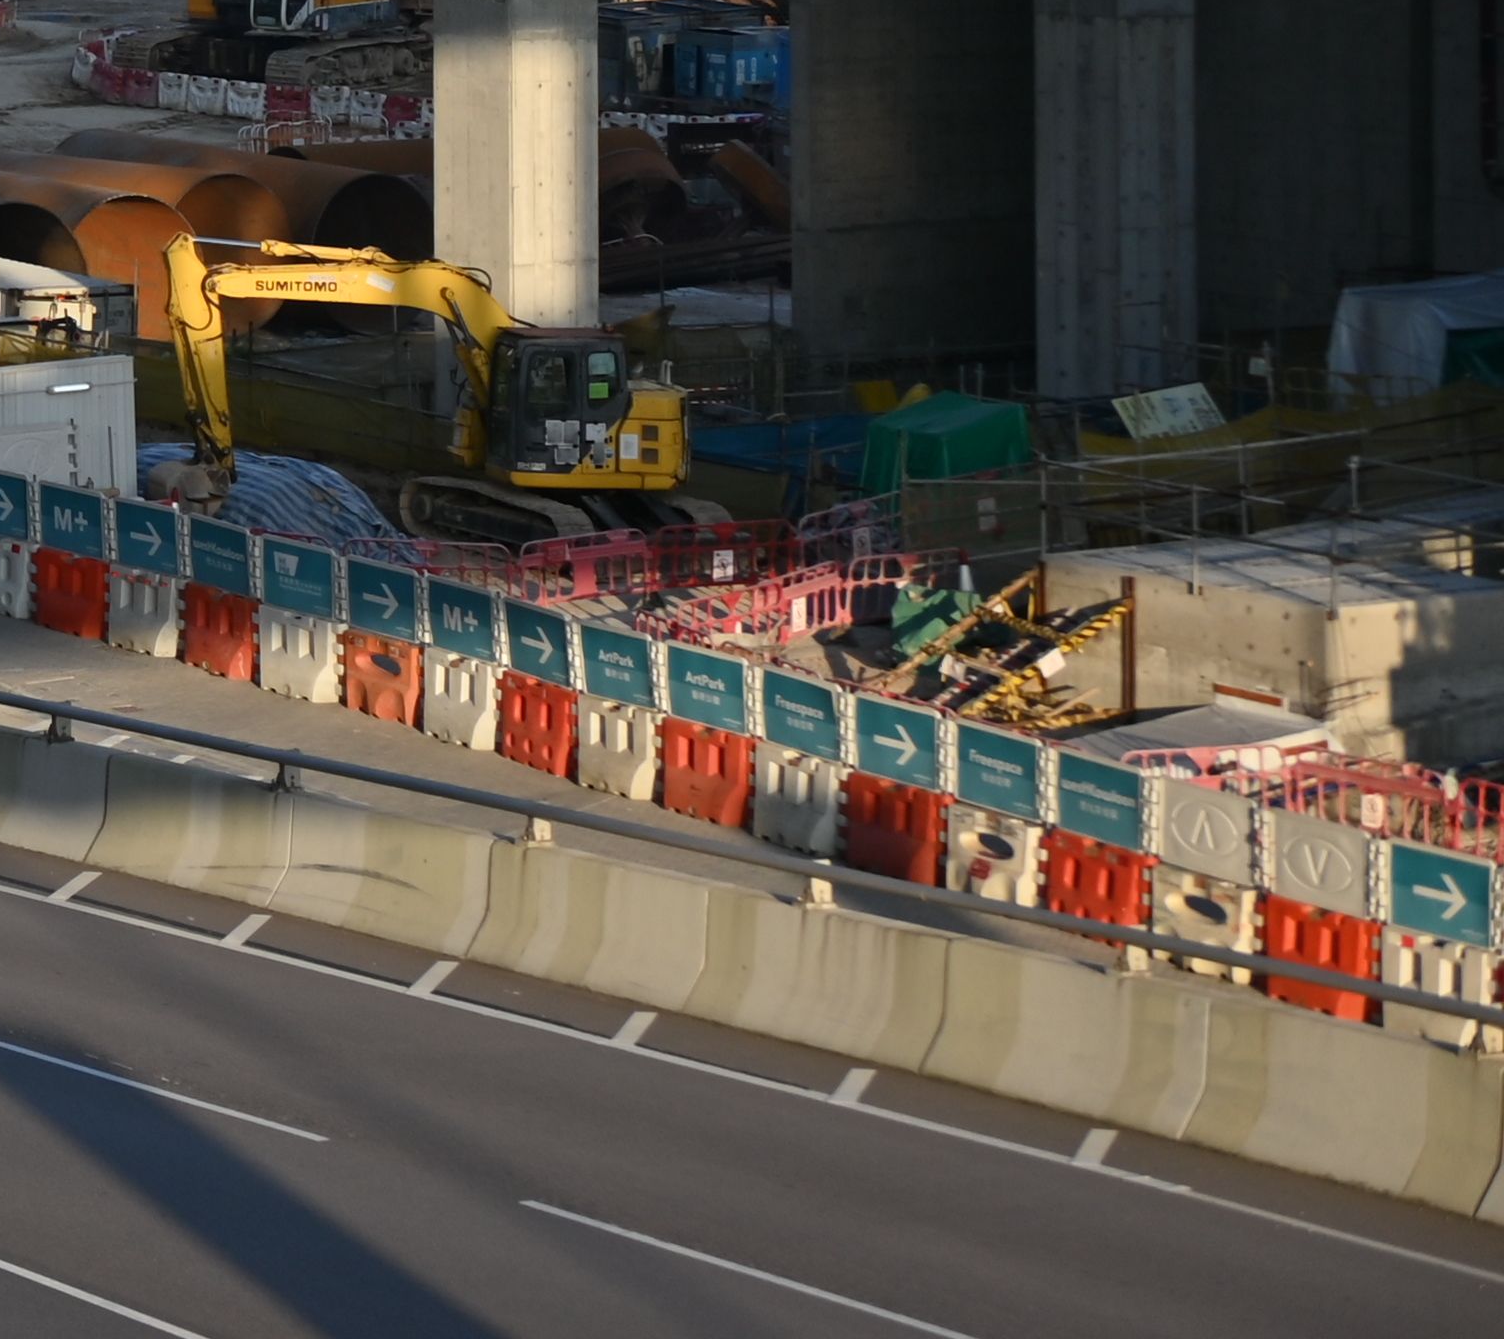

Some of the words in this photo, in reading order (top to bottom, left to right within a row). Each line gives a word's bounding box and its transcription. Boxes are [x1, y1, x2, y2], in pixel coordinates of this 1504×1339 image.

[255, 280, 338, 292] SUMITOMO
[53, 506, 88, 533] M+
[442, 603, 479, 633] M+
[598, 649, 635, 668] ArtPark
[685, 671, 726, 692] ArtPark
[774, 694, 825, 721] Freespace
[969, 748, 1024, 777] Freespace
